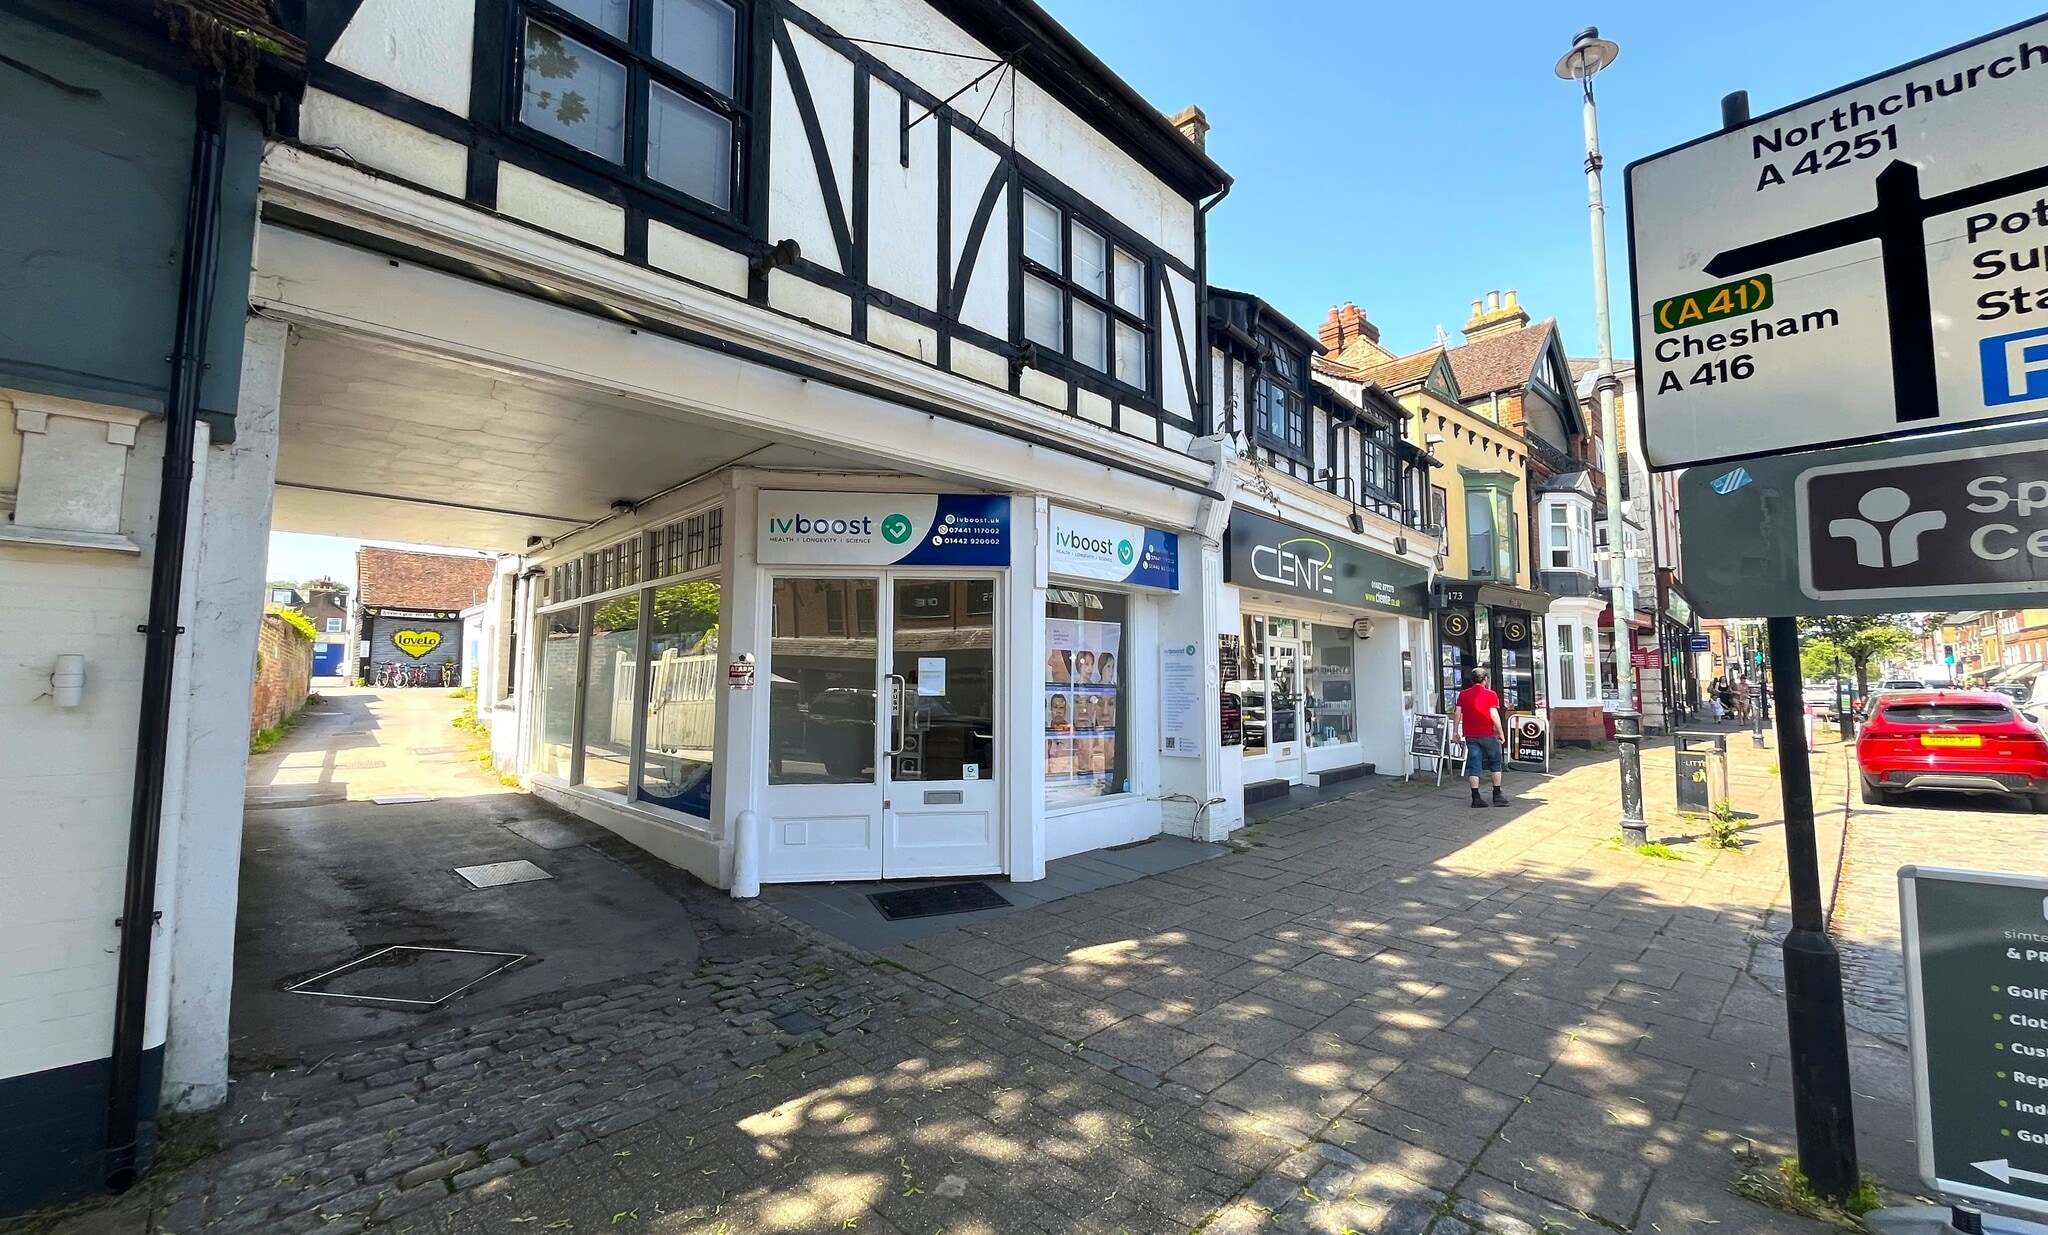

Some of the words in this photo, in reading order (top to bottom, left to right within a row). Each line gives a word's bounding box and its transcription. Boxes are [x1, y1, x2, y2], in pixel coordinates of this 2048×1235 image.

[1753, 42, 2048, 159] Northchurch
[1972, 244, 2048, 280] Su
[1655, 308, 1839, 363] Chesham
[769, 511, 872, 535] ivboost
[944, 537, 968, 545] 01442
[970, 538, 1000, 546] 920002
[1056, 525, 1113, 556] ivboost
[1448, 591, 1463, 600] 173
[1519, 748, 1544, 757] OPEN
[2011, 1042, 2048, 1058] Cus
